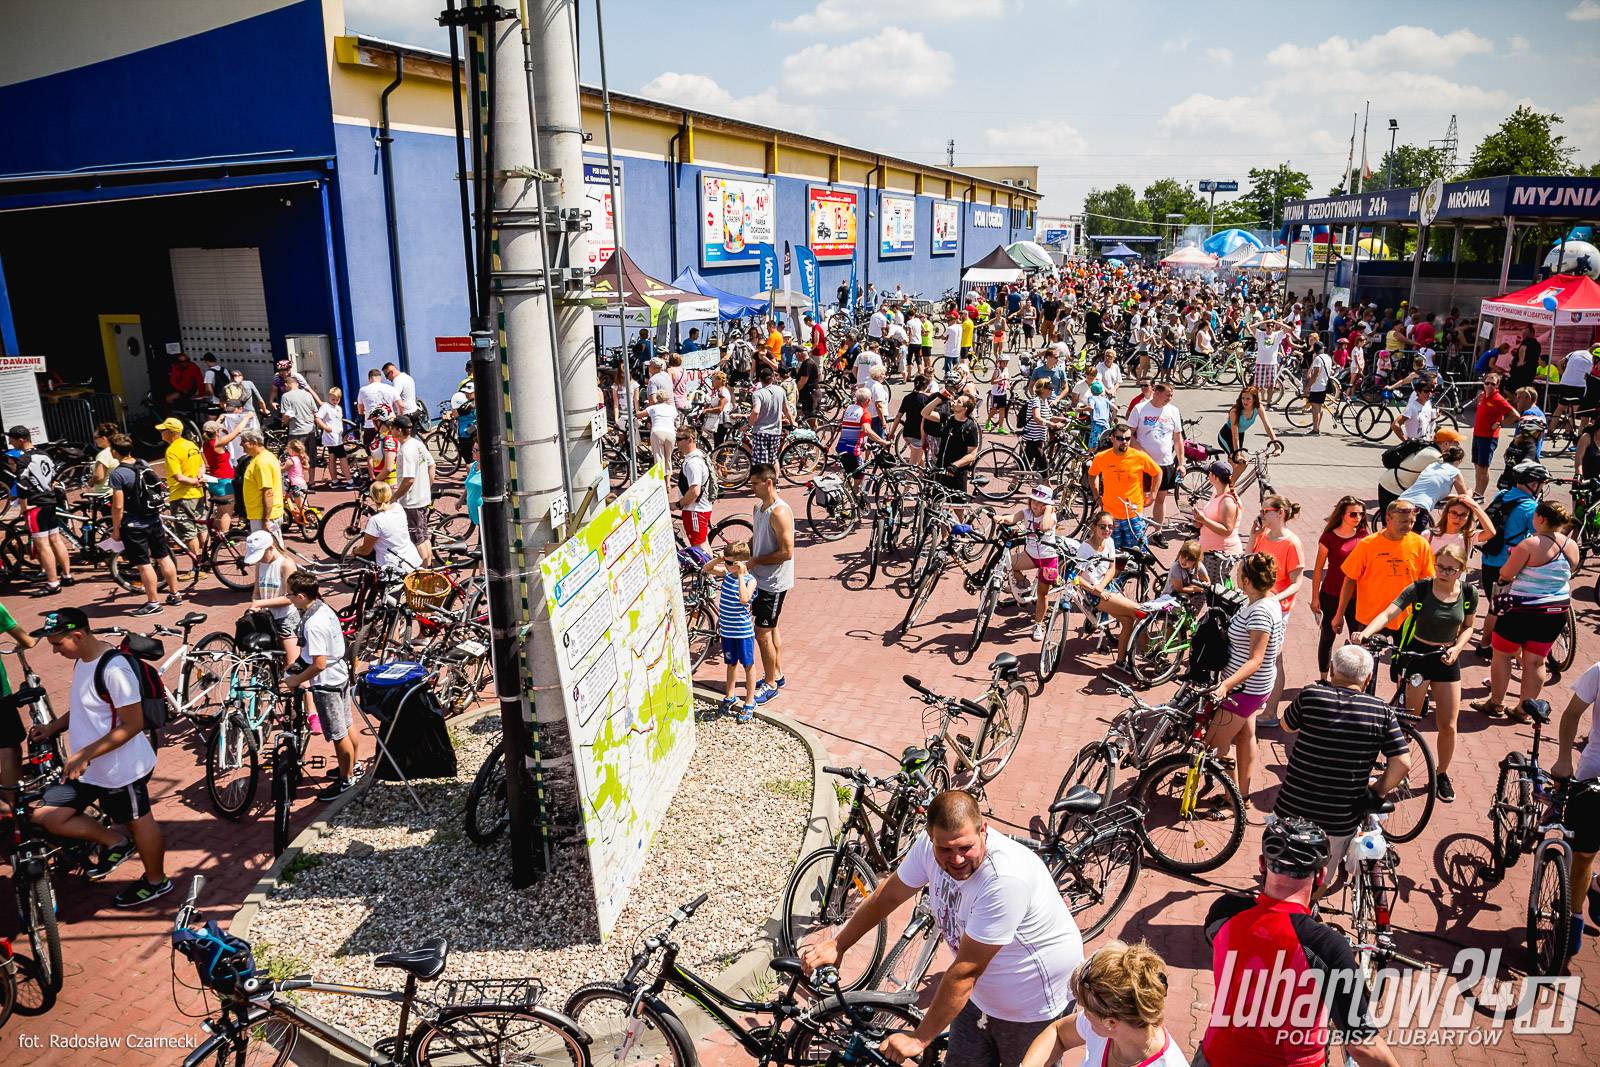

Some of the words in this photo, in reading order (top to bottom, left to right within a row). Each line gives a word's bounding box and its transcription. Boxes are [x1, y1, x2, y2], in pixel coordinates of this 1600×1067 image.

[1447, 185, 1490, 209] MRÓWKA
[1284, 204, 1304, 220] MYJNIA
[1307, 199, 1362, 219] BEZDOTYKOWA
[0, 357, 41, 365] DAWANIE
